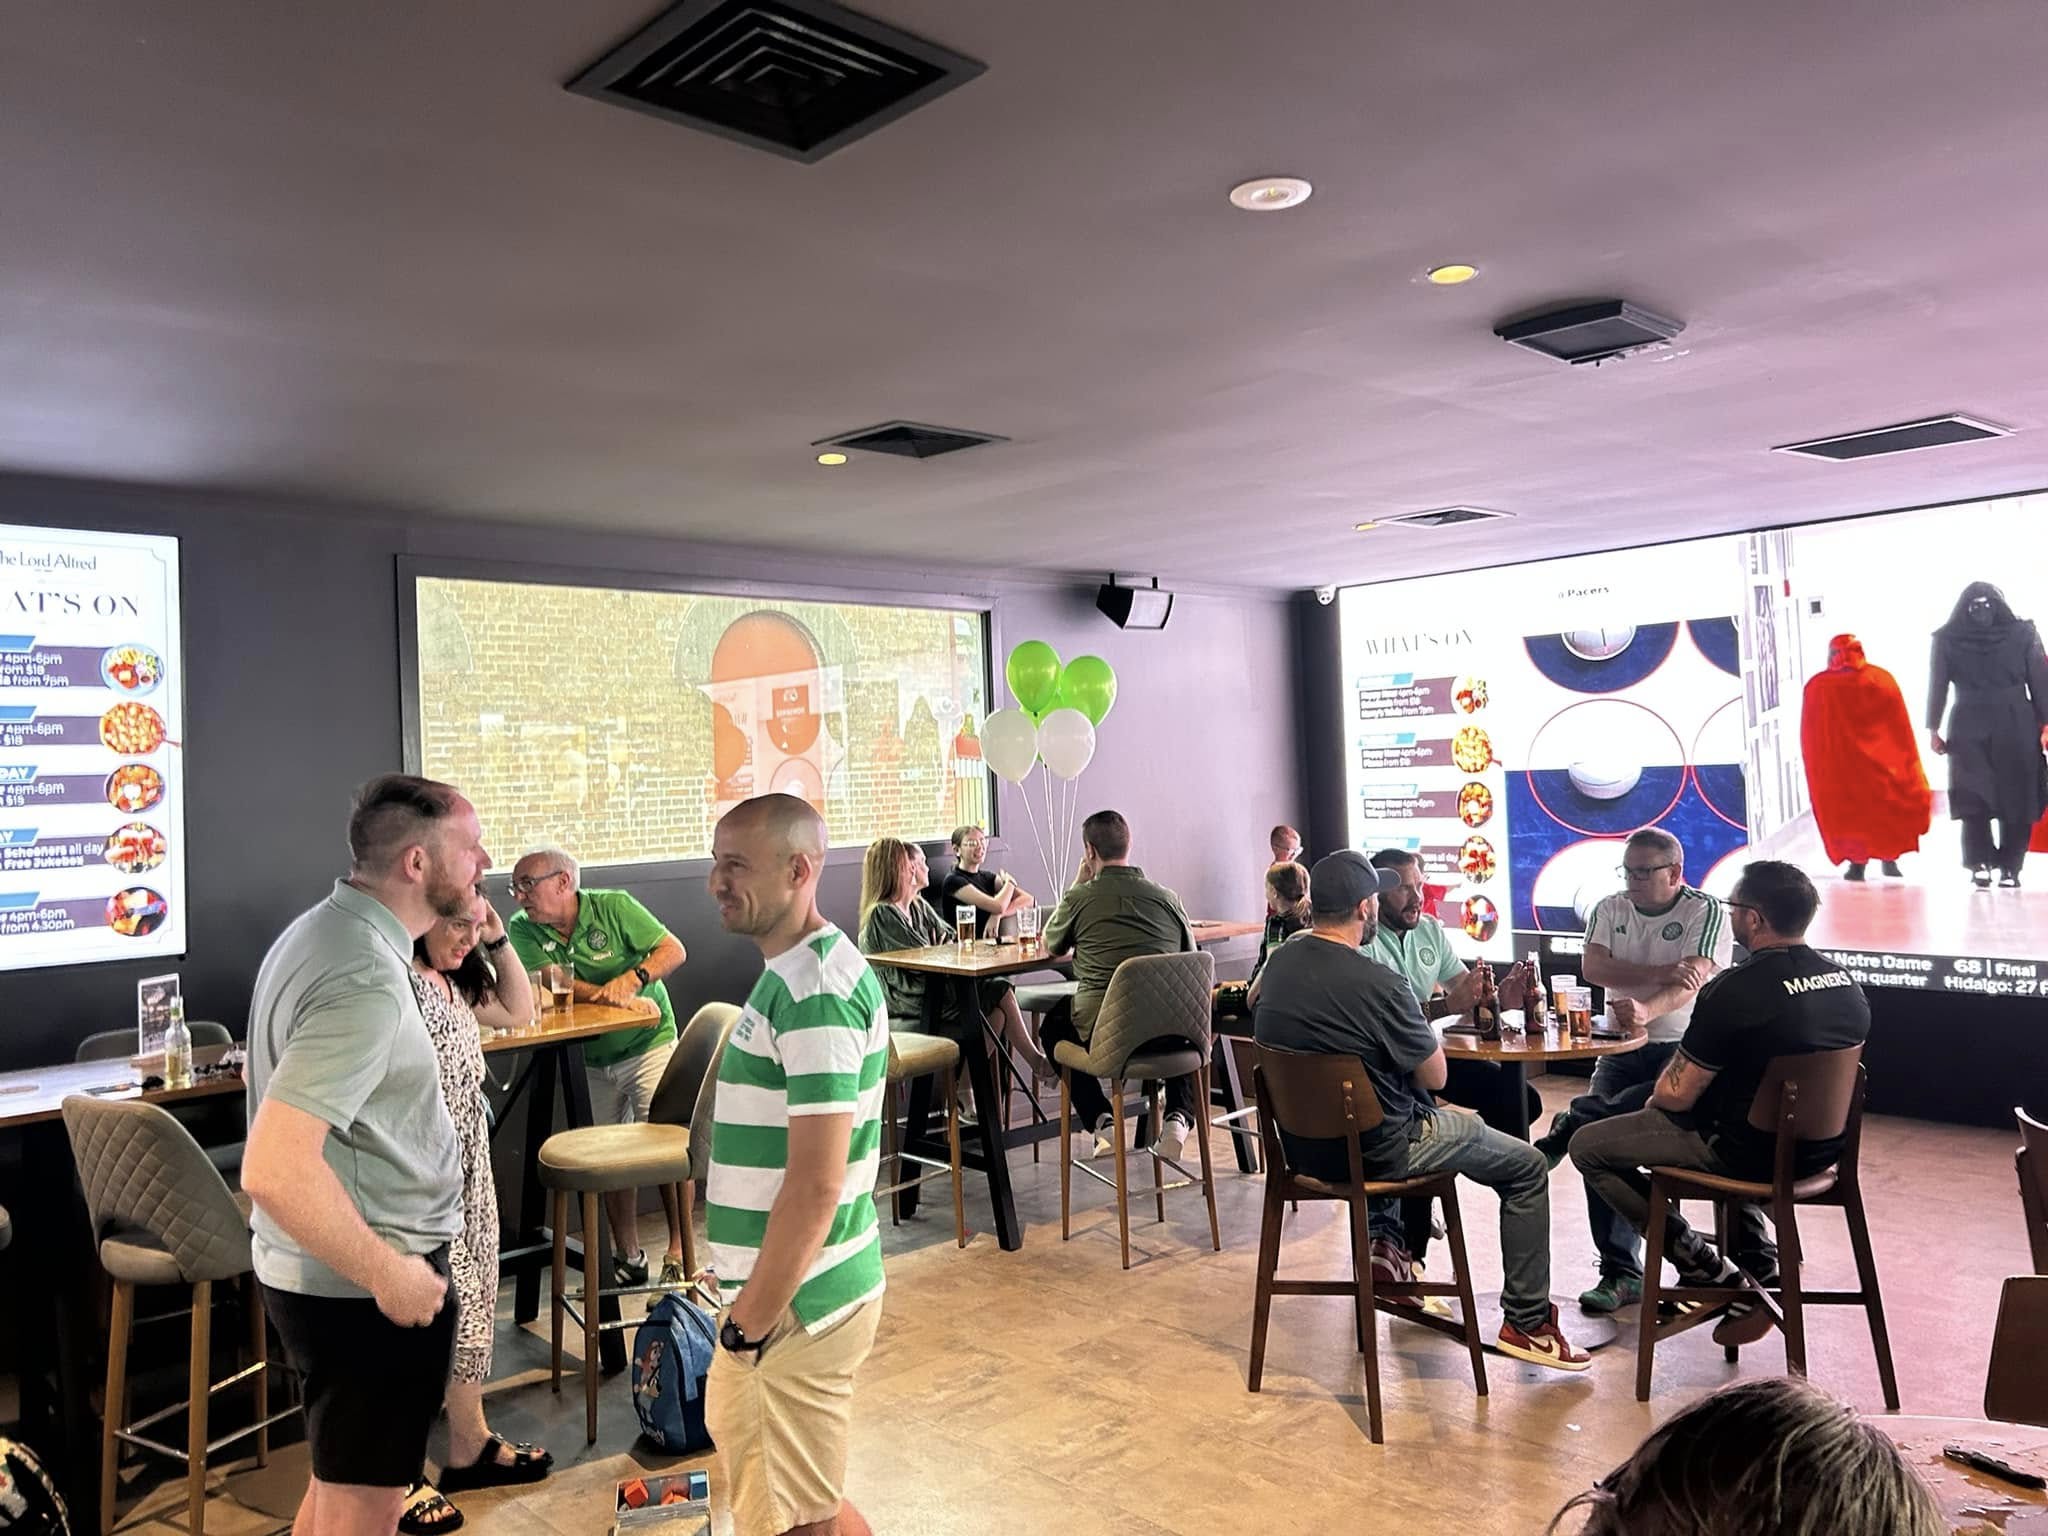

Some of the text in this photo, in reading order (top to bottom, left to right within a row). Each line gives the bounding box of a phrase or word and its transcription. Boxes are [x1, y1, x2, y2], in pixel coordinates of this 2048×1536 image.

[20, 551, 50, 567] Lord
[54, 553, 97, 570] Alfred
[93, 595, 138, 617] ON
[13, 674, 41, 687] from
[43, 675, 69, 687] 7pm
[69, 843, 82, 855] all
[83, 842, 104, 856] day
[1834, 952, 1880, 968] Notre
[1881, 955, 1933, 971] Dame
[1953, 959, 1982, 974] 68
[1995, 962, 2037, 977] Final
[1783, 971, 1852, 995] MAGNERS
[1850, 970, 1928, 986] th quarter
[1943, 976, 2013, 994] Hidalgo:
[2015, 980, 2038, 994] 27
